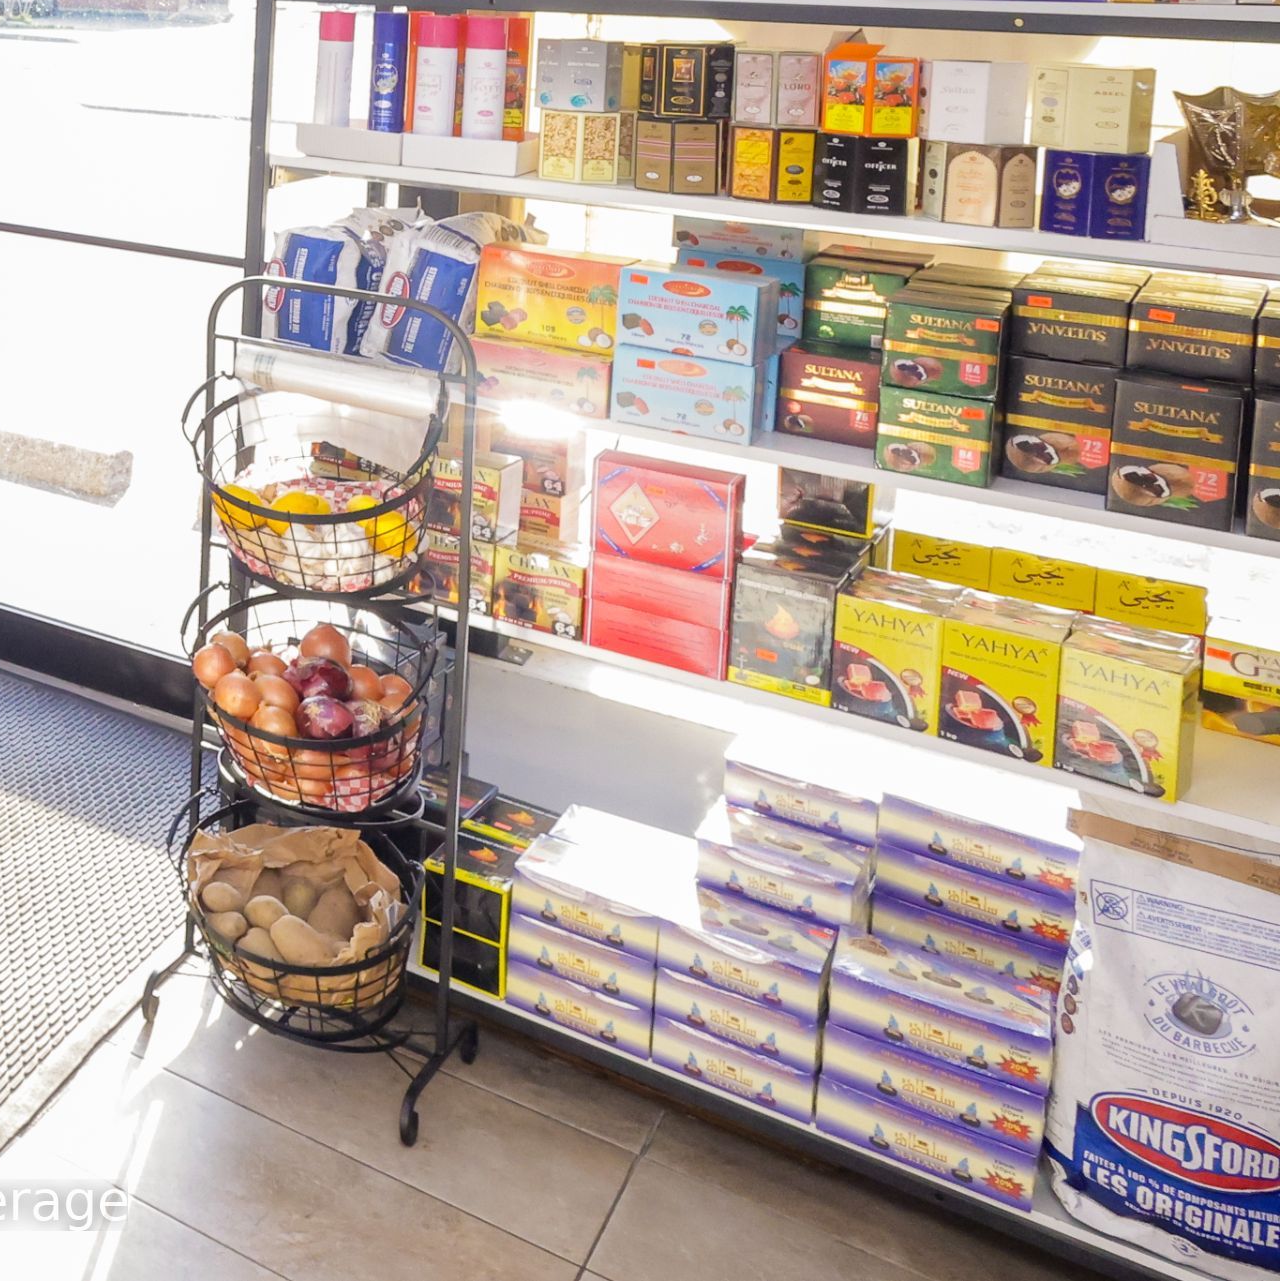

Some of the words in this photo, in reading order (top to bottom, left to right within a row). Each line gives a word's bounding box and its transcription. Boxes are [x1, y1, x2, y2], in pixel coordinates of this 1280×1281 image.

[910, 313, 973, 332] SULTANA
[1029, 322, 1107, 342] SULTANA
[1149, 338, 1232, 360] SULTANA
[805, 364, 862, 382] SULTANA
[1024, 374, 1102, 395] SULTANA
[902, 397, 964, 415] SULTANA
[1134, 401, 1218, 425] SULTANA
[1083, 439, 1103, 452] 72
[1197, 471, 1218, 486] 72
[554, 621, 576, 634] 64
[852, 609, 928, 637] YAHYA
[839, 642, 862, 656] NEW
[961, 632, 1041, 664] YAHYA
[947, 667, 970, 682] NEW
[1079, 660, 1160, 695] YAHYA
[1063, 696, 1088, 711] NEW
[1152, 980, 1169, 995] LE
[1152, 1016, 1170, 1034] DU
[1172, 1031, 1248, 1054] BARBECUE
[1151, 1086, 1202, 1108] DEPUIS
[1208, 1103, 1244, 1121] 1920
[1109, 1105, 1280, 1180] KINGSFORD
[1082, 1160, 1128, 1198] LES
[1084, 1150, 1116, 1170] FAITES
[1127, 1170, 1146, 1184] 100
[1162, 1183, 1176, 1196] DE
[1178, 1188, 1247, 1218] COMPOSANTS
